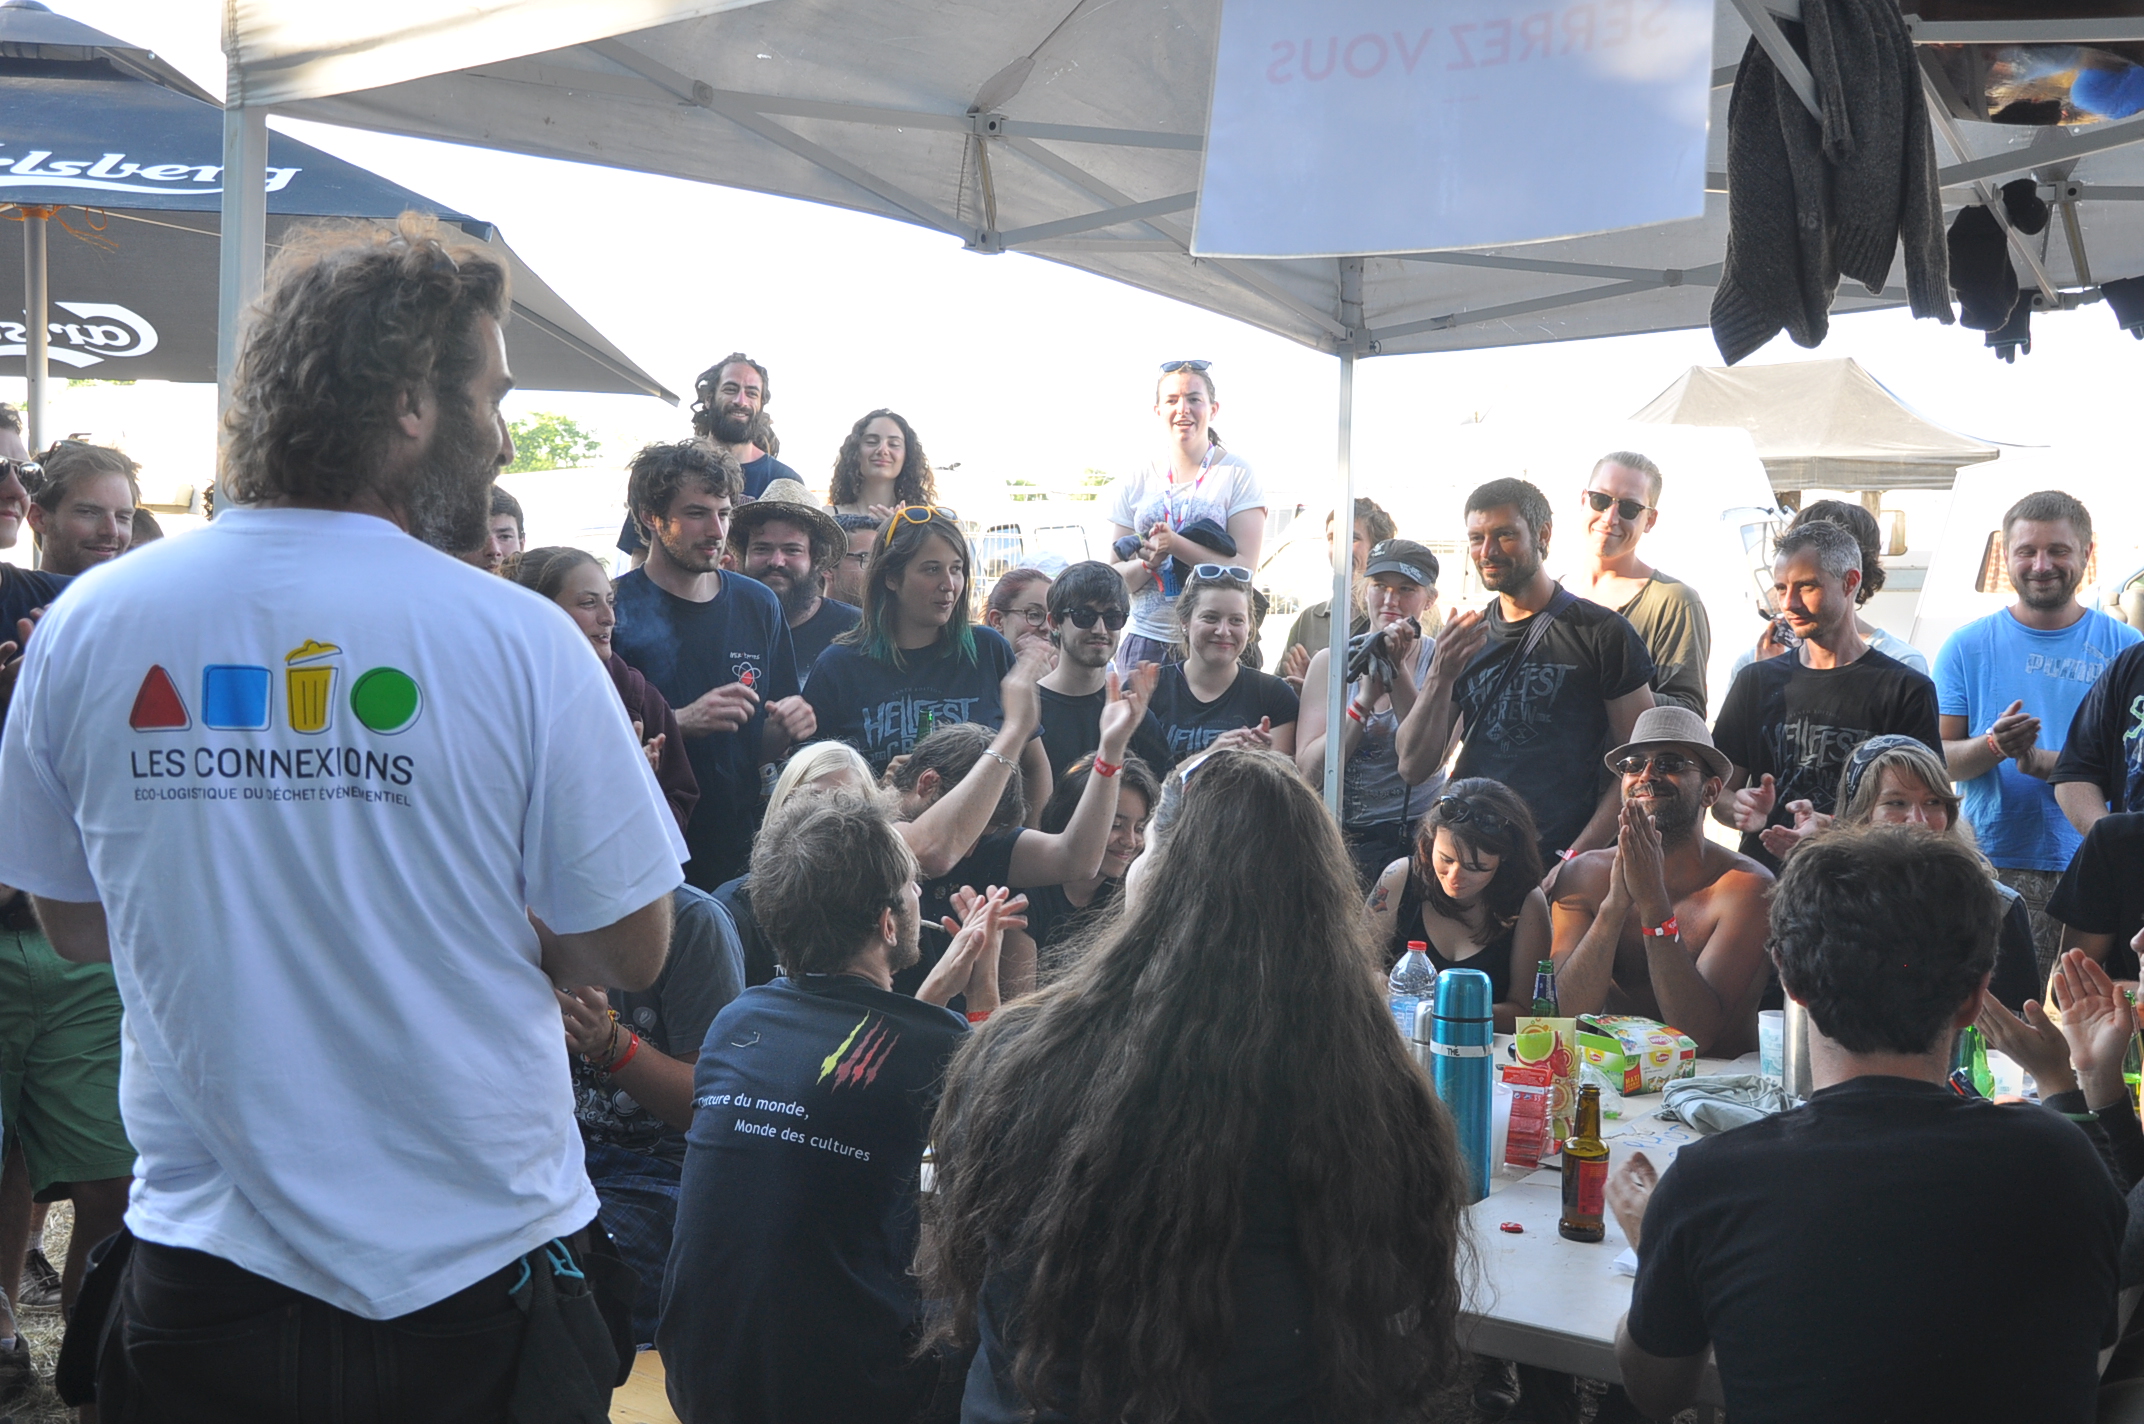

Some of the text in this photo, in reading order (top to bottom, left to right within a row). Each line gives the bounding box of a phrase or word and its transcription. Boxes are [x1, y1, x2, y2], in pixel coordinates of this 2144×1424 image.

[0, 150, 302, 193] lsberg
[2025, 653, 2104, 684] PUMA
[1467, 662, 1578, 711] HEFEST
[862, 694, 980, 748] HELLFEST
[1486, 700, 1537, 725] CREW
[131, 747, 414, 785] LES CONNEXIONS
[134, 786, 238, 801] ÉCO-LOGISTIQUE
[243, 787, 264, 800] DU
[267, 786, 316, 801] DÉCHET
[1625, 1074, 1640, 1084] MAXI
[698, 1093, 810, 1121] Cture du monde,
[734, 1118, 871, 1162] Monde des cultures
